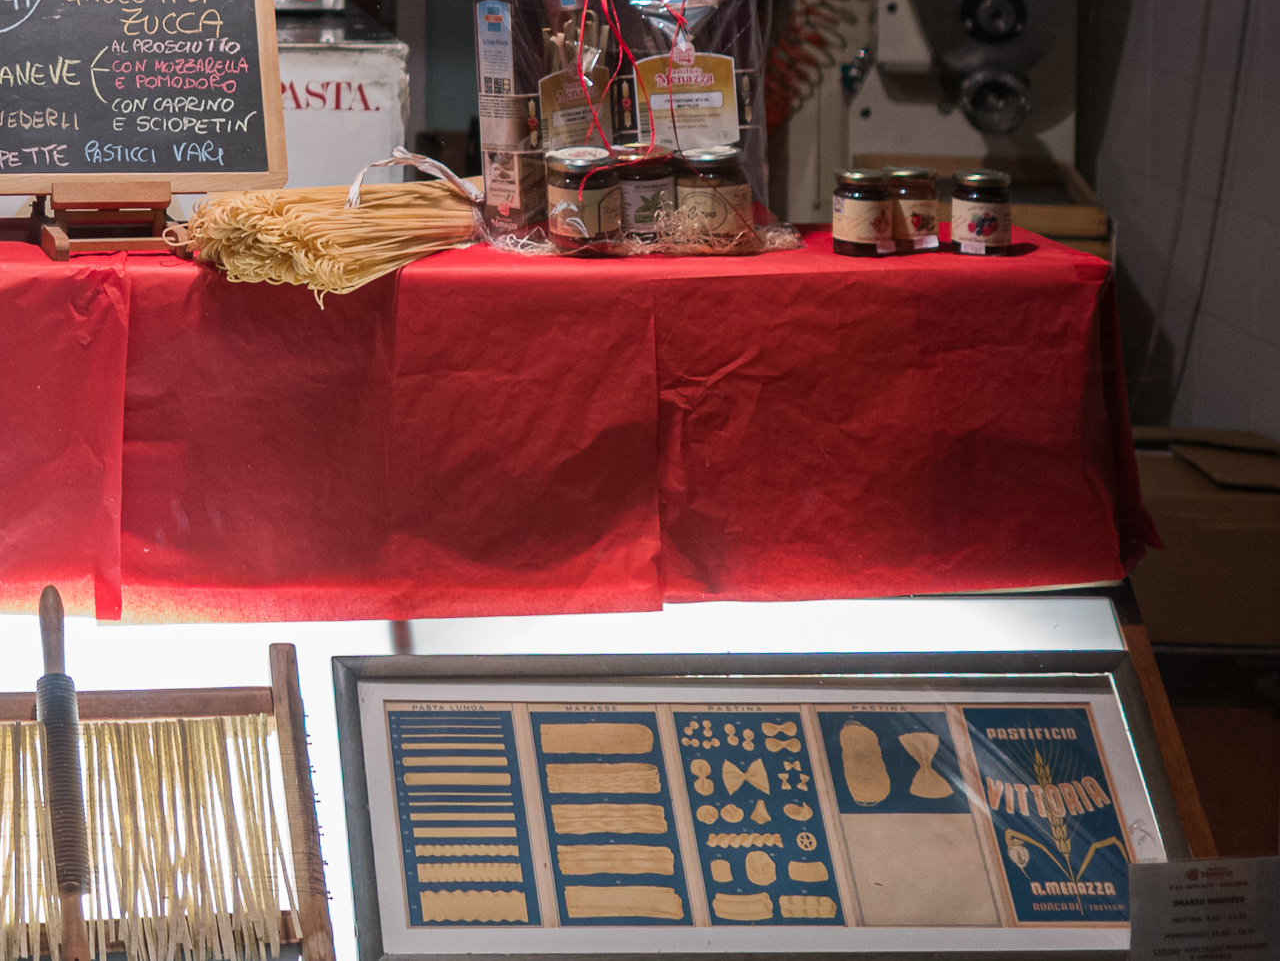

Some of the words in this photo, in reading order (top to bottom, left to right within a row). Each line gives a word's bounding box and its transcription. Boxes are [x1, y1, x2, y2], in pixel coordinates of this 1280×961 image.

[120, 8, 223, 37] ZUCCA
[111, 40, 129, 54] AL
[132, 37, 241, 54] PROSCIUTTO
[112, 59, 148, 73] CON
[154, 57, 249, 75] MOZZARELLA
[115, 77, 125, 89] E
[135, 74, 237, 93] POMODORO
[111, 98, 146, 112] CON
[153, 98, 234, 113] CAPRINO
[113, 117, 125, 131] E
[137, 112, 258, 134] SCIOPETIN
[84, 140, 156, 163] PASTICCI
[173, 140, 224, 166] VARI
[986, 727, 1078, 740] PASTIFICIO
[986, 776, 1111, 818] VITTORIA
[1173, 898, 1205, 907] ORARIO
[1207, 896, 1245, 905] NEGOZIO
